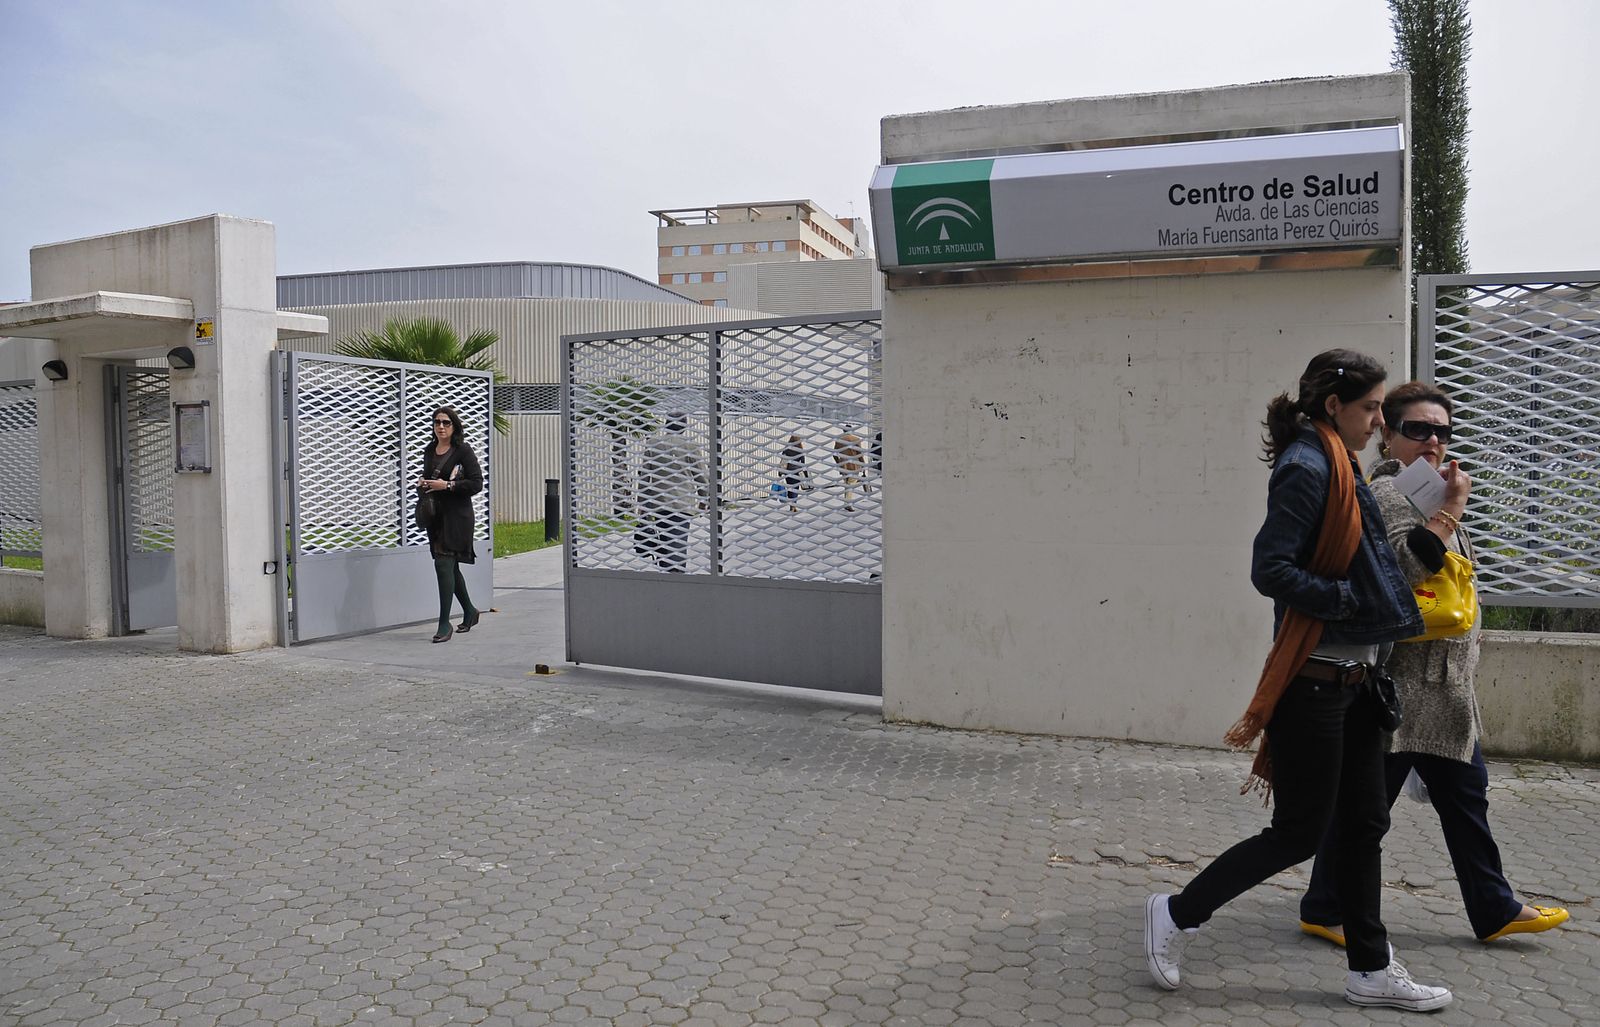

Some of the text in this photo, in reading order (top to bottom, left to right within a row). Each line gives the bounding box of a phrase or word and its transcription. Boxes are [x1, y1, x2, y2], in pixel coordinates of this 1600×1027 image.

[1168, 171, 1379, 206] Centro de Salud
[1215, 197, 1379, 222] Avda. de Las Ciencias
[1203, 224, 1279, 244] Fuensanta
[1284, 221, 1325, 239] Perez
[1329, 218, 1379, 240] Quirós
[908, 242, 984, 256] JUNTA DE ANDALUCIA
